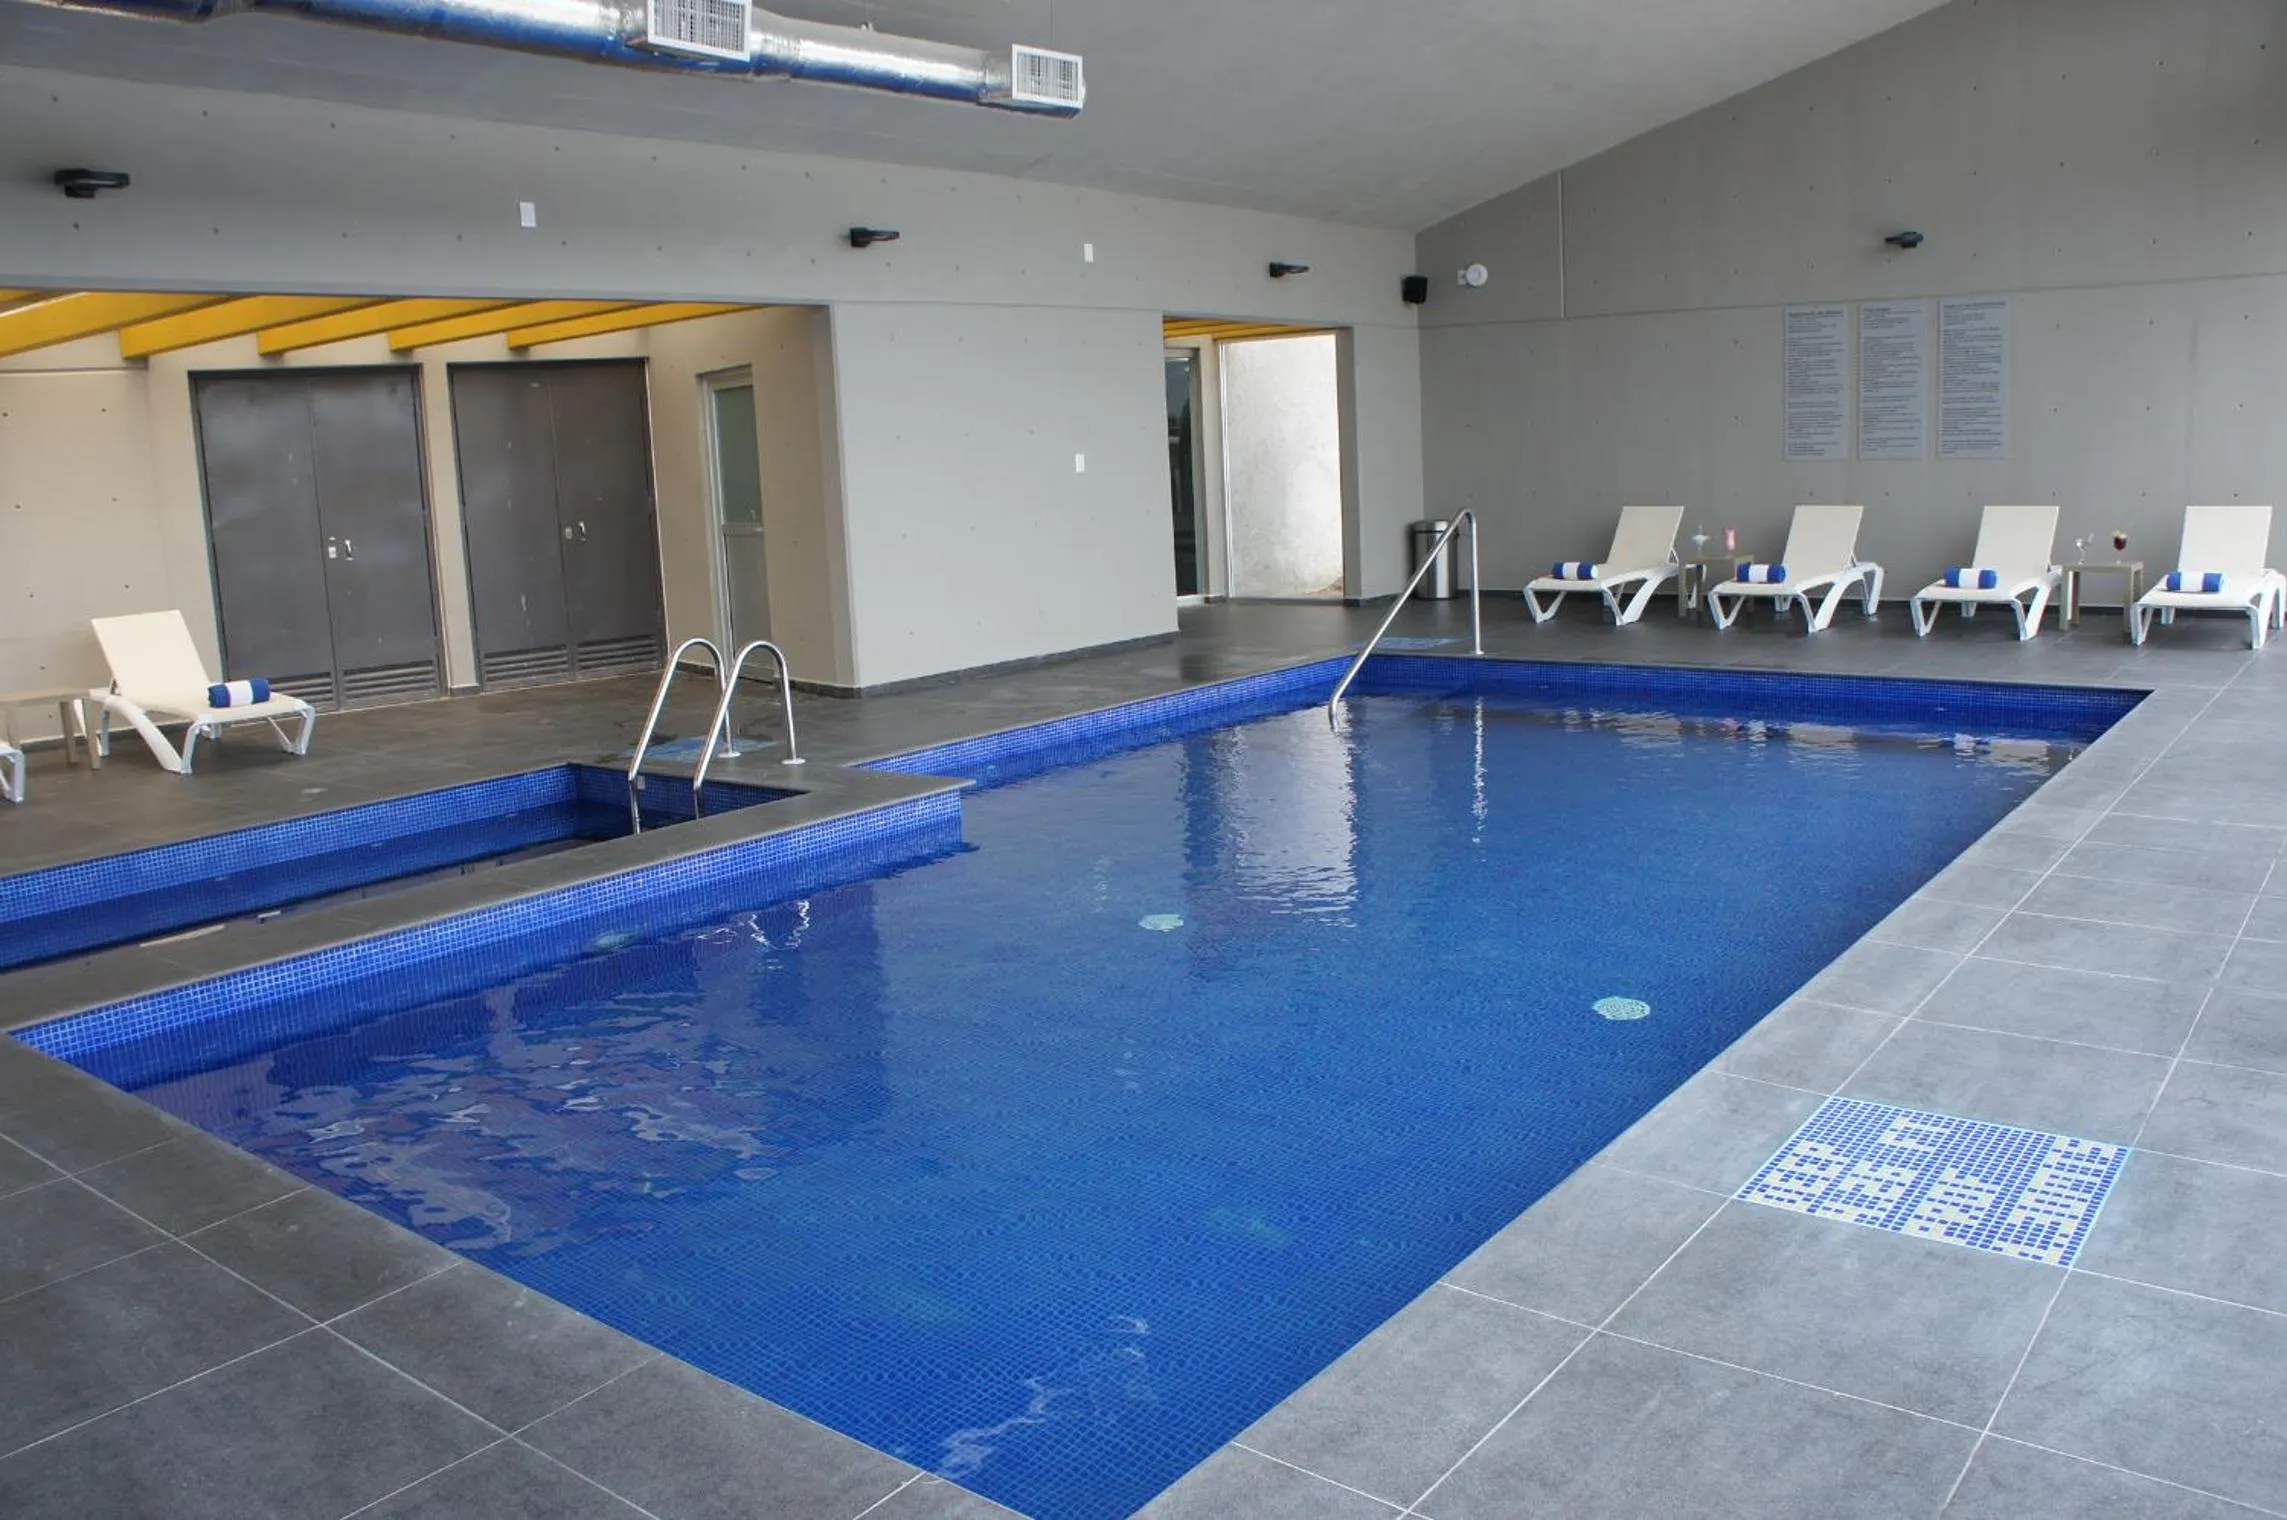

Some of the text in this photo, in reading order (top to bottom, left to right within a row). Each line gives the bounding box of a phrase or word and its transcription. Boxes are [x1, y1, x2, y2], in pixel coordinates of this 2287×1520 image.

[1877, 1115, 1952, 1152] FT
[1747, 1140, 1858, 1211] DEEP
[1902, 1167, 2005, 1244] PROF
